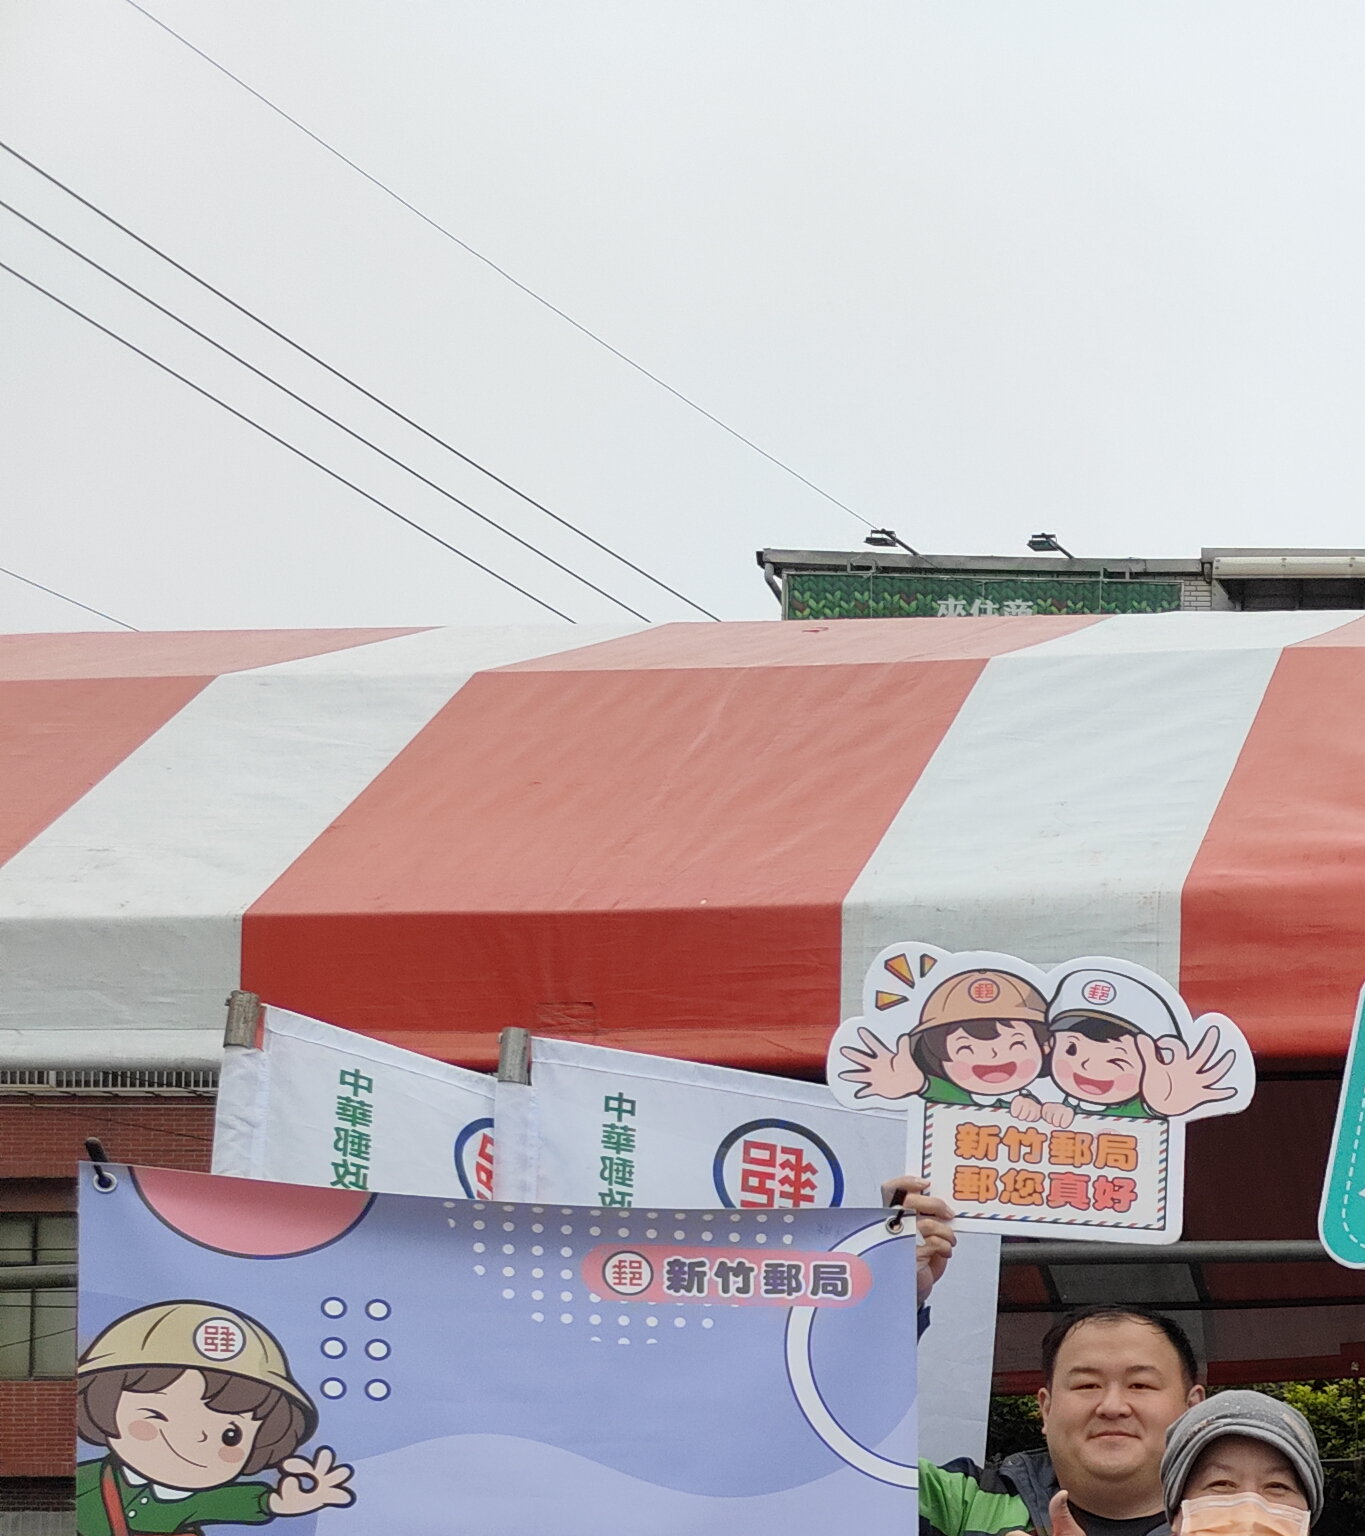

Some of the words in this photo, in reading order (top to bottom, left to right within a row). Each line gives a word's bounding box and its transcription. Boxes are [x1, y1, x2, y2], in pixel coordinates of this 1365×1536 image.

[954, 1122, 1138, 1172] 新竹郵局
[953, 1165, 1138, 1213] 郵您真好
[664, 1257, 852, 1301] 新竹郵局
